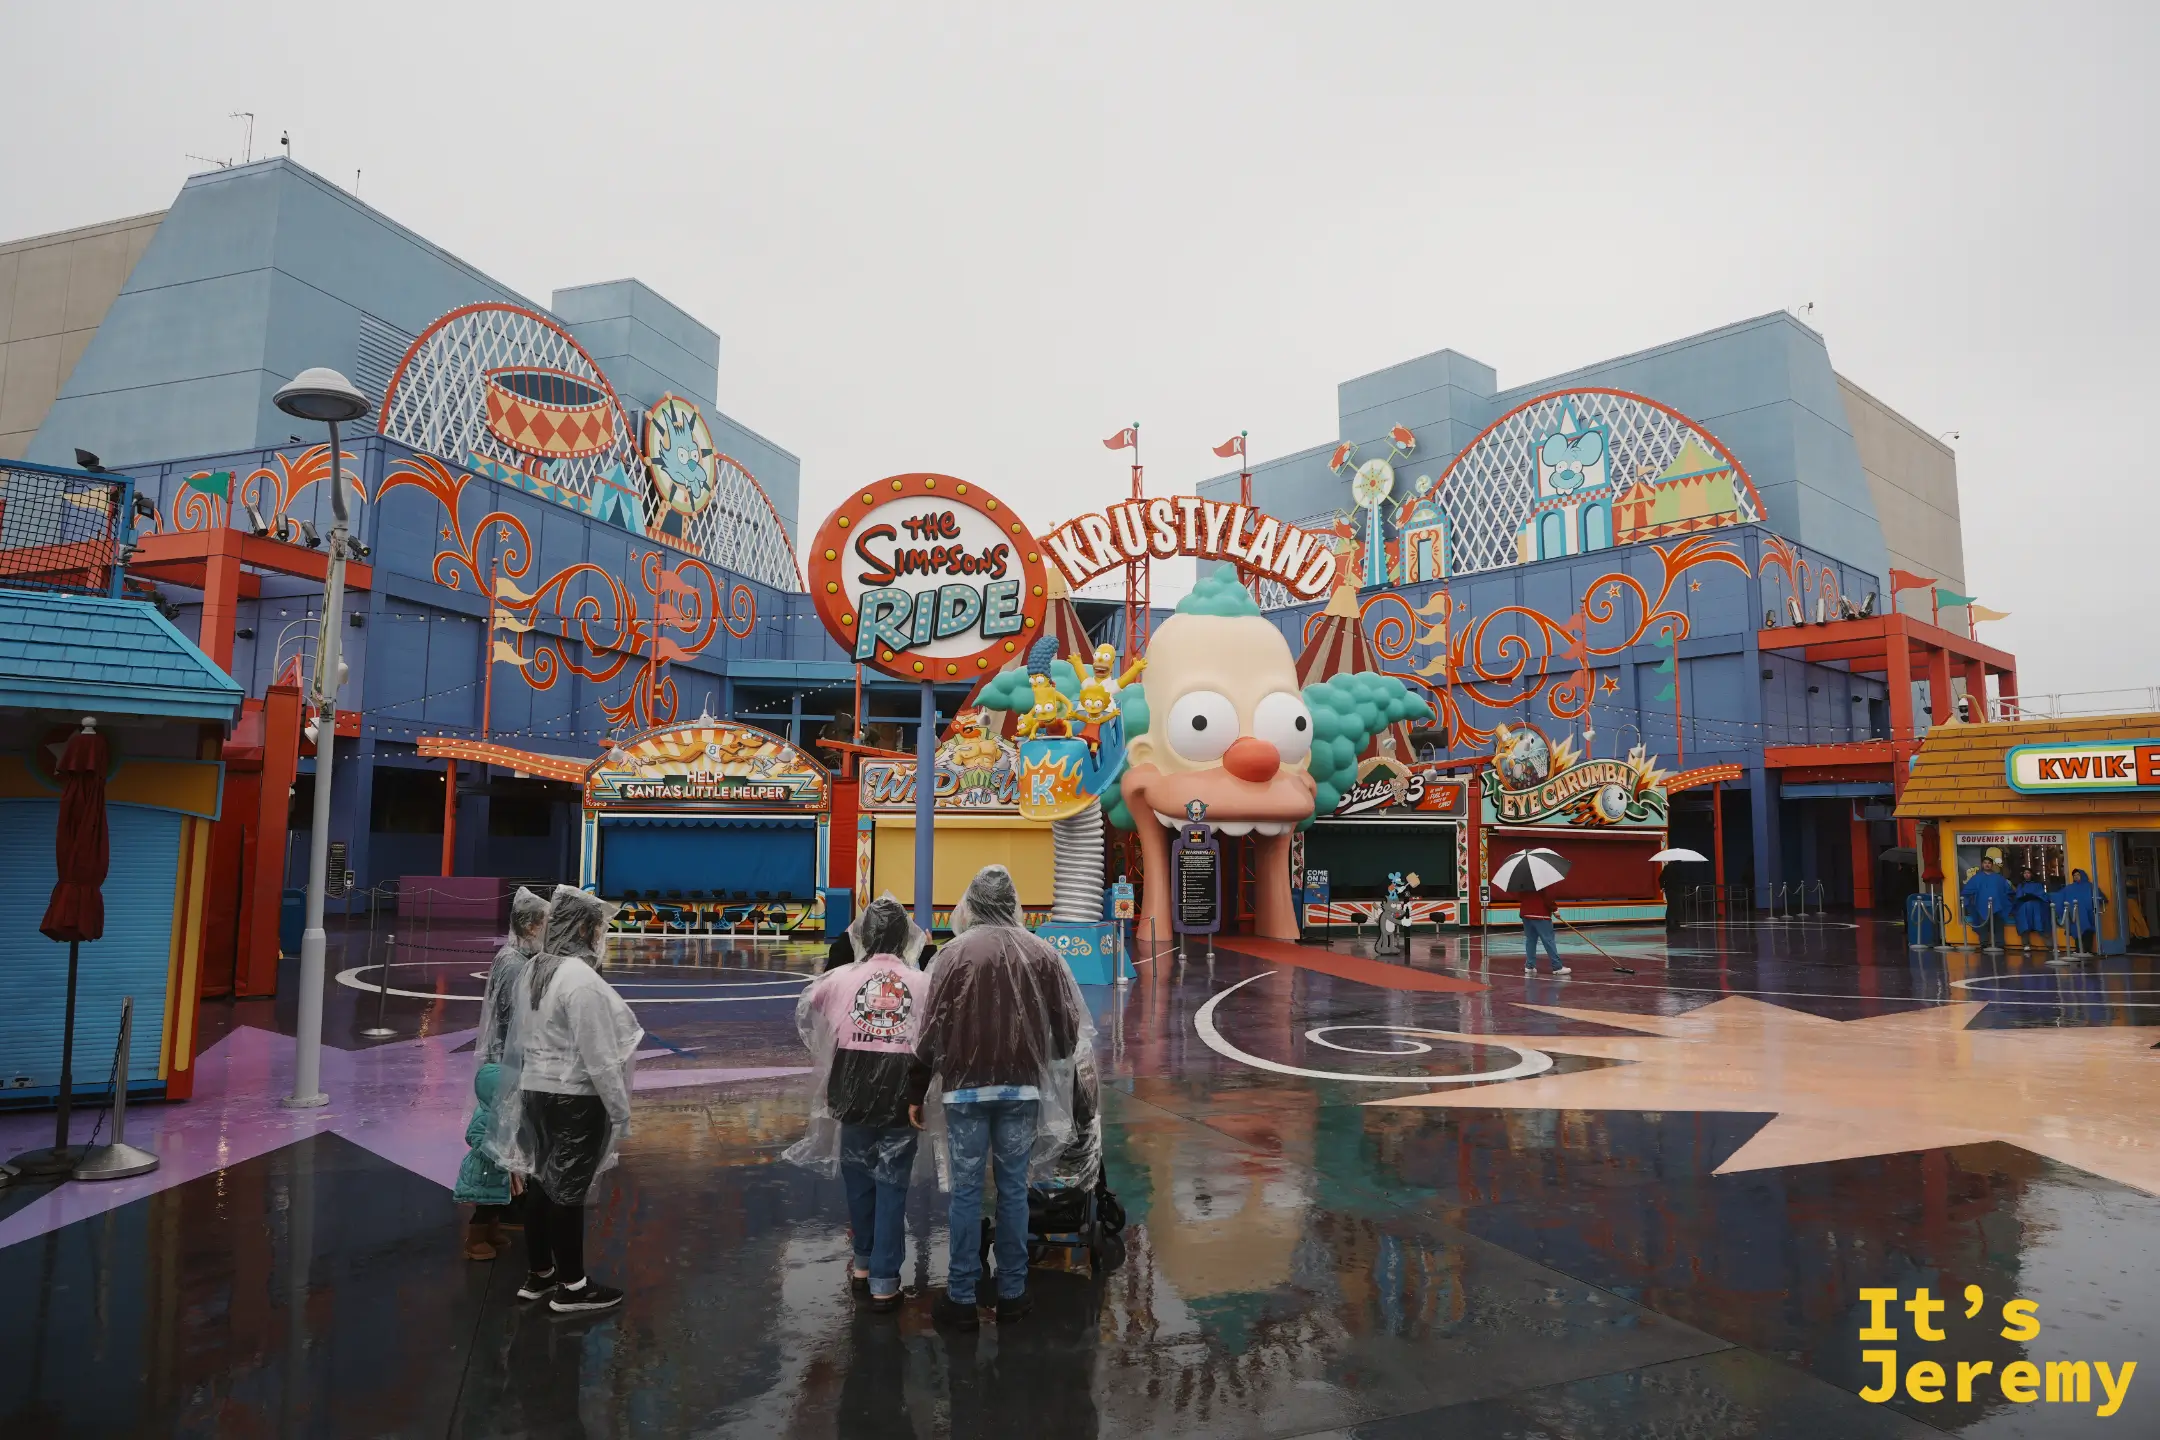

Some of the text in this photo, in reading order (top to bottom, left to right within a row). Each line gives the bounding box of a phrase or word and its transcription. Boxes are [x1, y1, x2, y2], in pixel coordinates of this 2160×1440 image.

[1123, 430, 1133, 445] K
[1233, 438, 1242, 453] K
[1045, 497, 1338, 597] KRUSTYLAND
[851, 580, 1024, 663] RIDE
[708, 744, 717, 755] 8
[686, 770, 725, 784] HELP
[626, 784, 785, 800] SANTA'S LITTLE HELPER
[962, 788, 992, 806] AND
[1031, 774, 1056, 806] K
[1405, 775, 1426, 803] 3
[1502, 763, 1640, 817] EYE CARUMBA!
[1961, 835, 2057, 844] SOUVENIRS NOVELTIES
[1307, 869, 1329, 877] COME
[1319, 876, 1329, 884] IN
[857, 1019, 907, 1036] HELLO KITT
